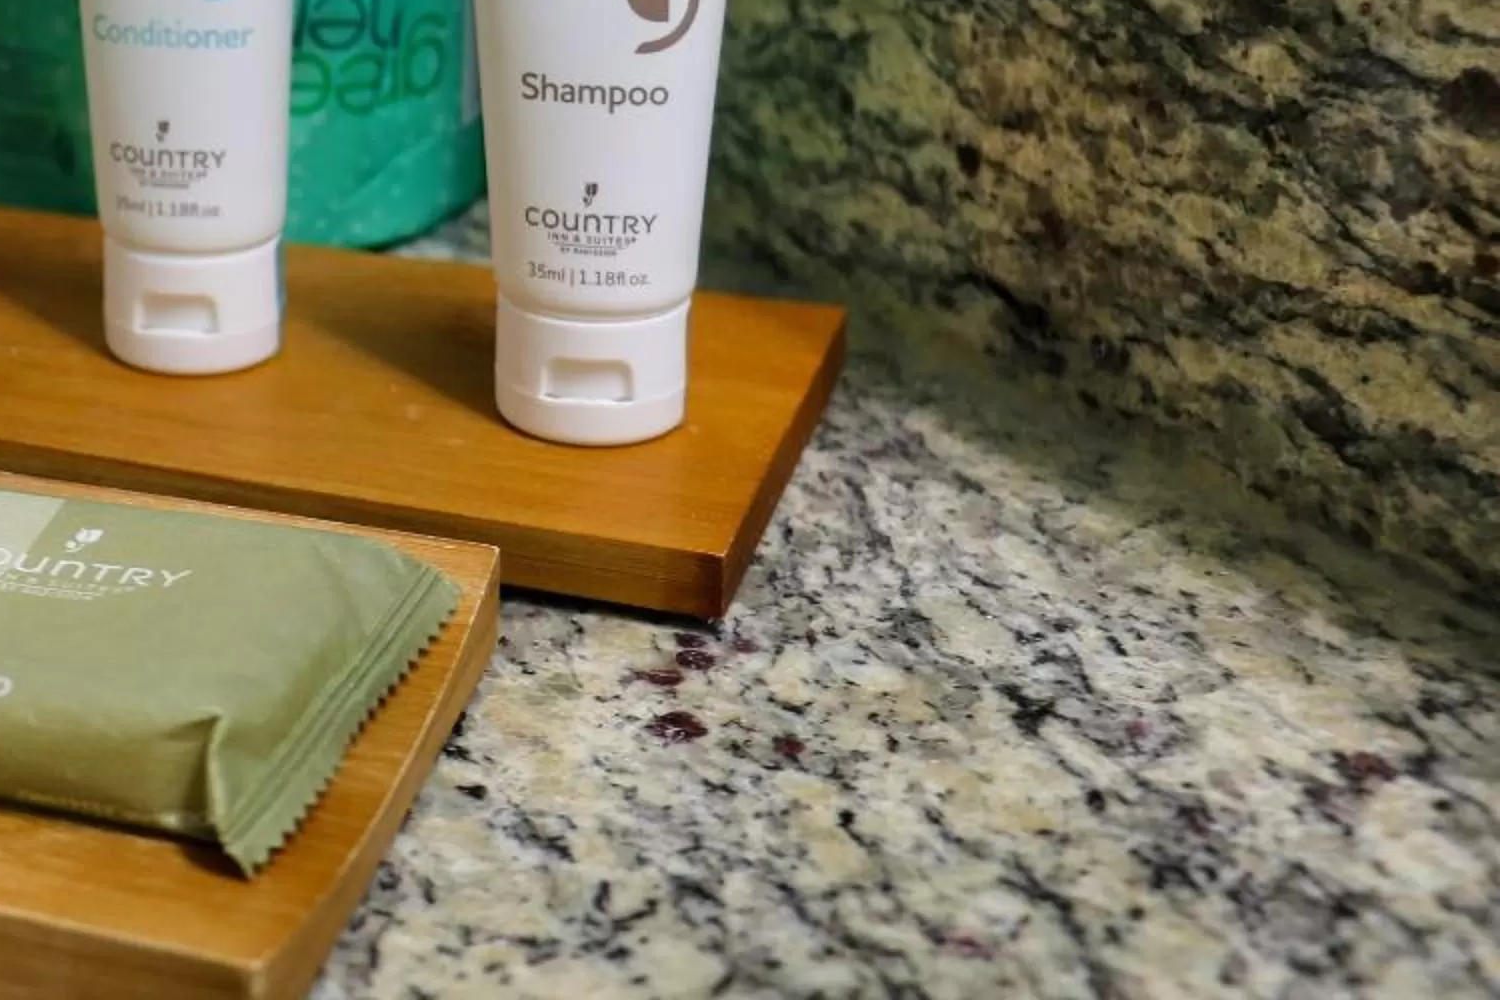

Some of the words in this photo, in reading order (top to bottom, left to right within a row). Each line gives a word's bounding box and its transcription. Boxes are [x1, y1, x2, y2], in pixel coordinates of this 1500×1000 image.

[92, 14, 253, 49] Conditioner
[521, 71, 669, 115] Shampoo
[109, 142, 227, 169] COUNTRY
[525, 206, 657, 235] COUNTRY
[528, 260, 566, 283] 35ml
